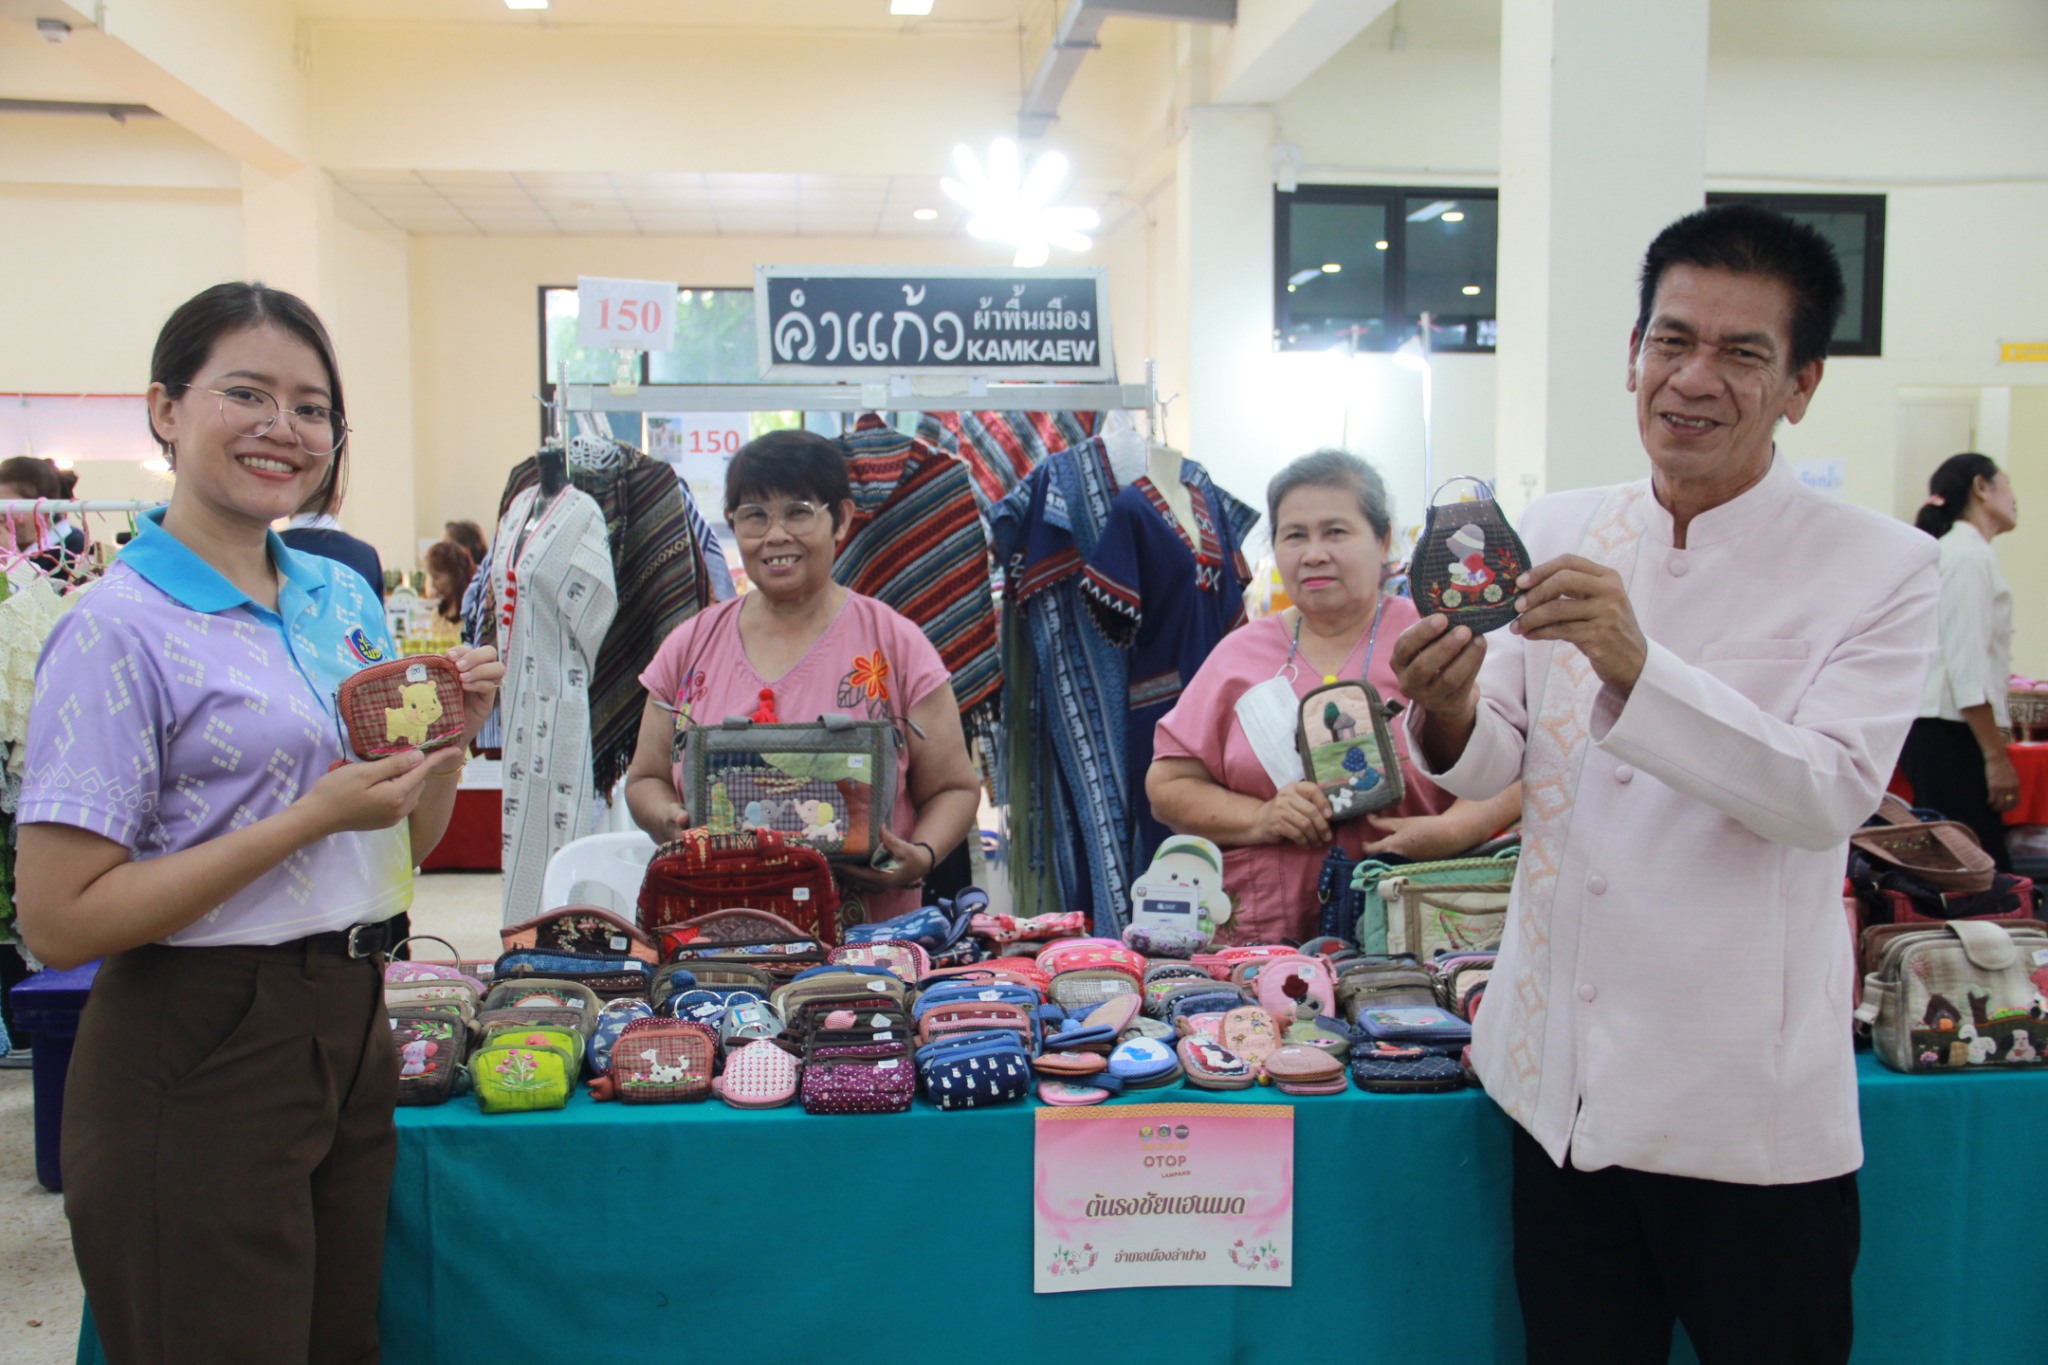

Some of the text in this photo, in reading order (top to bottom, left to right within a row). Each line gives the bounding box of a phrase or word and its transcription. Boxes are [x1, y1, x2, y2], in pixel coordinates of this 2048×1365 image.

[597, 297, 662, 334] 150
[973, 284, 1091, 331] ผ้าพื้นเมือง
[774, 284, 965, 362] คำแก้ว
[966, 339, 1097, 362] KAMKAEW
[688, 430, 741, 454] 150
[1144, 1155, 1187, 1168] OTOP
[1161, 1170, 1191, 1178] LAMPANG
